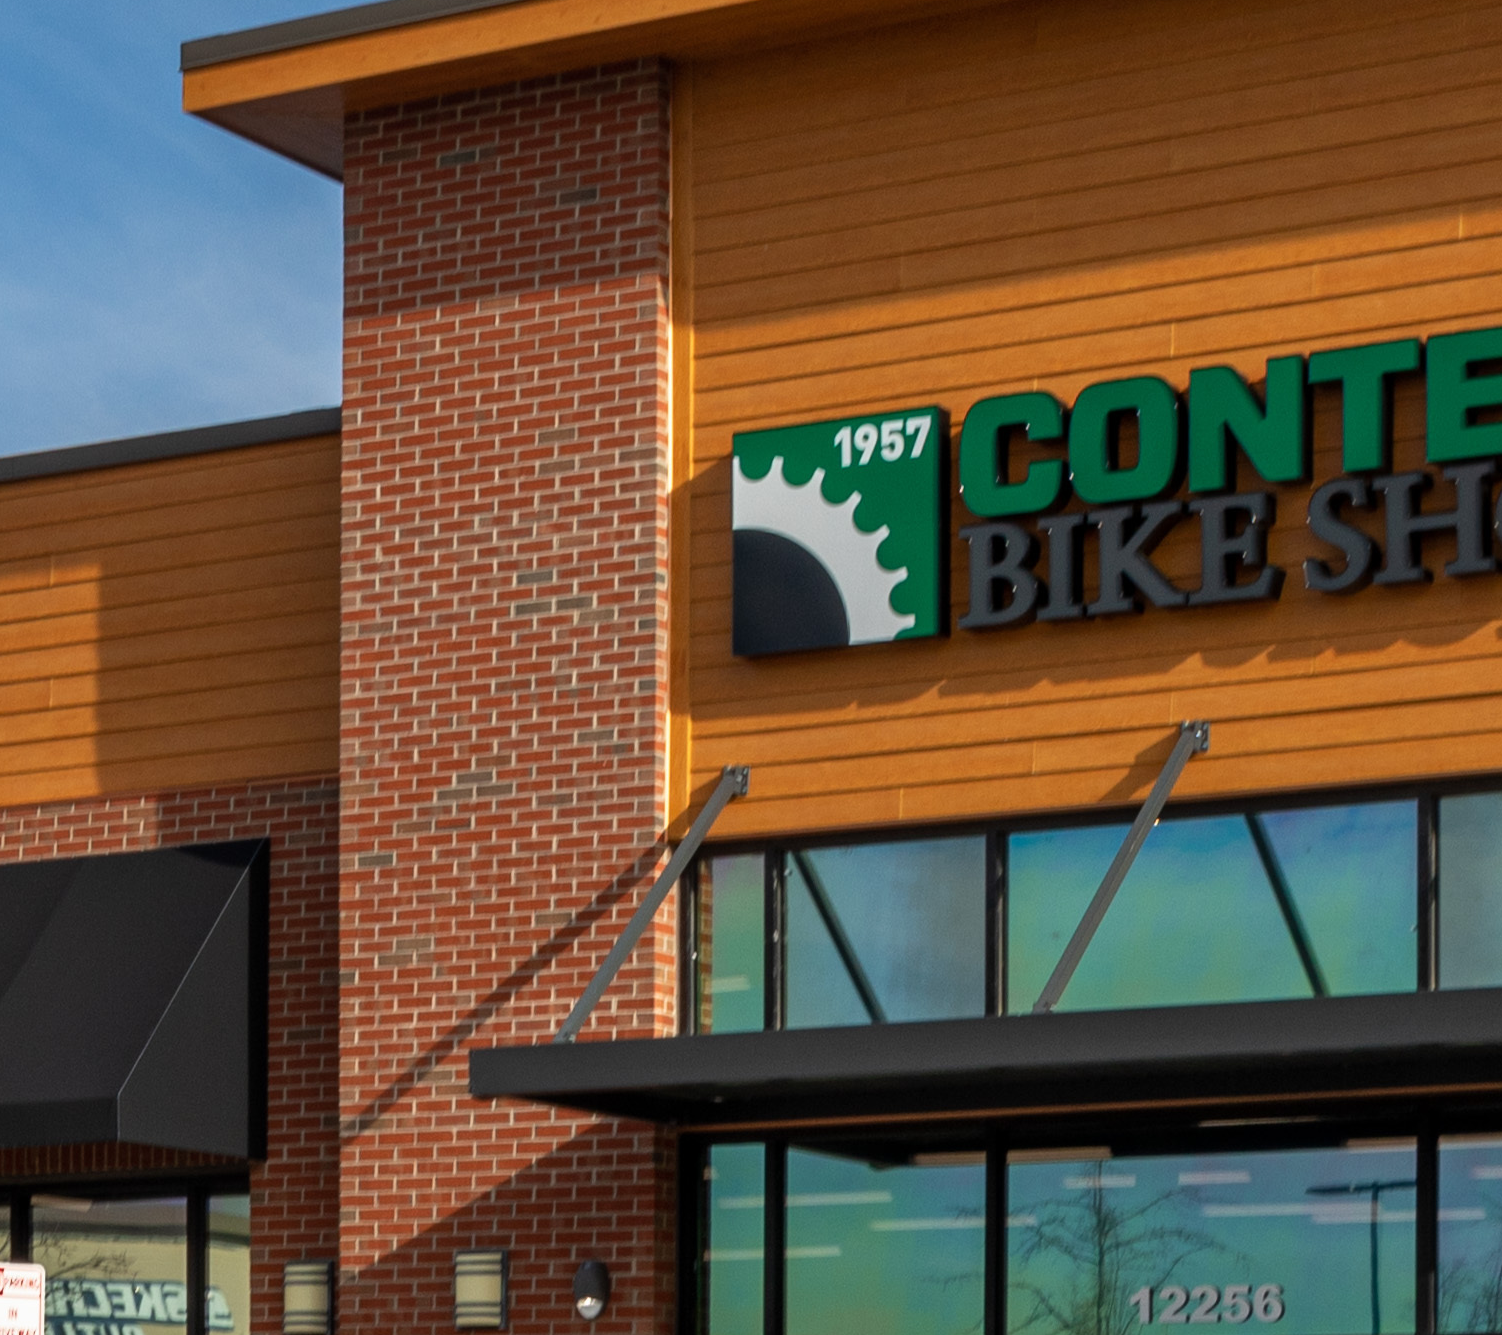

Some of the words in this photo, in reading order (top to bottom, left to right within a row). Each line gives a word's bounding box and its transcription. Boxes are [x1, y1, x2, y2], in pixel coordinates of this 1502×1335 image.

[833, 415, 932, 467] 1957
[957, 494, 1284, 630] BIKE
[3, 1277, 40, 1289] PARKING
[1129, 1283, 1285, 1325] 12256
[8, 1307, 18, 1319] IN
